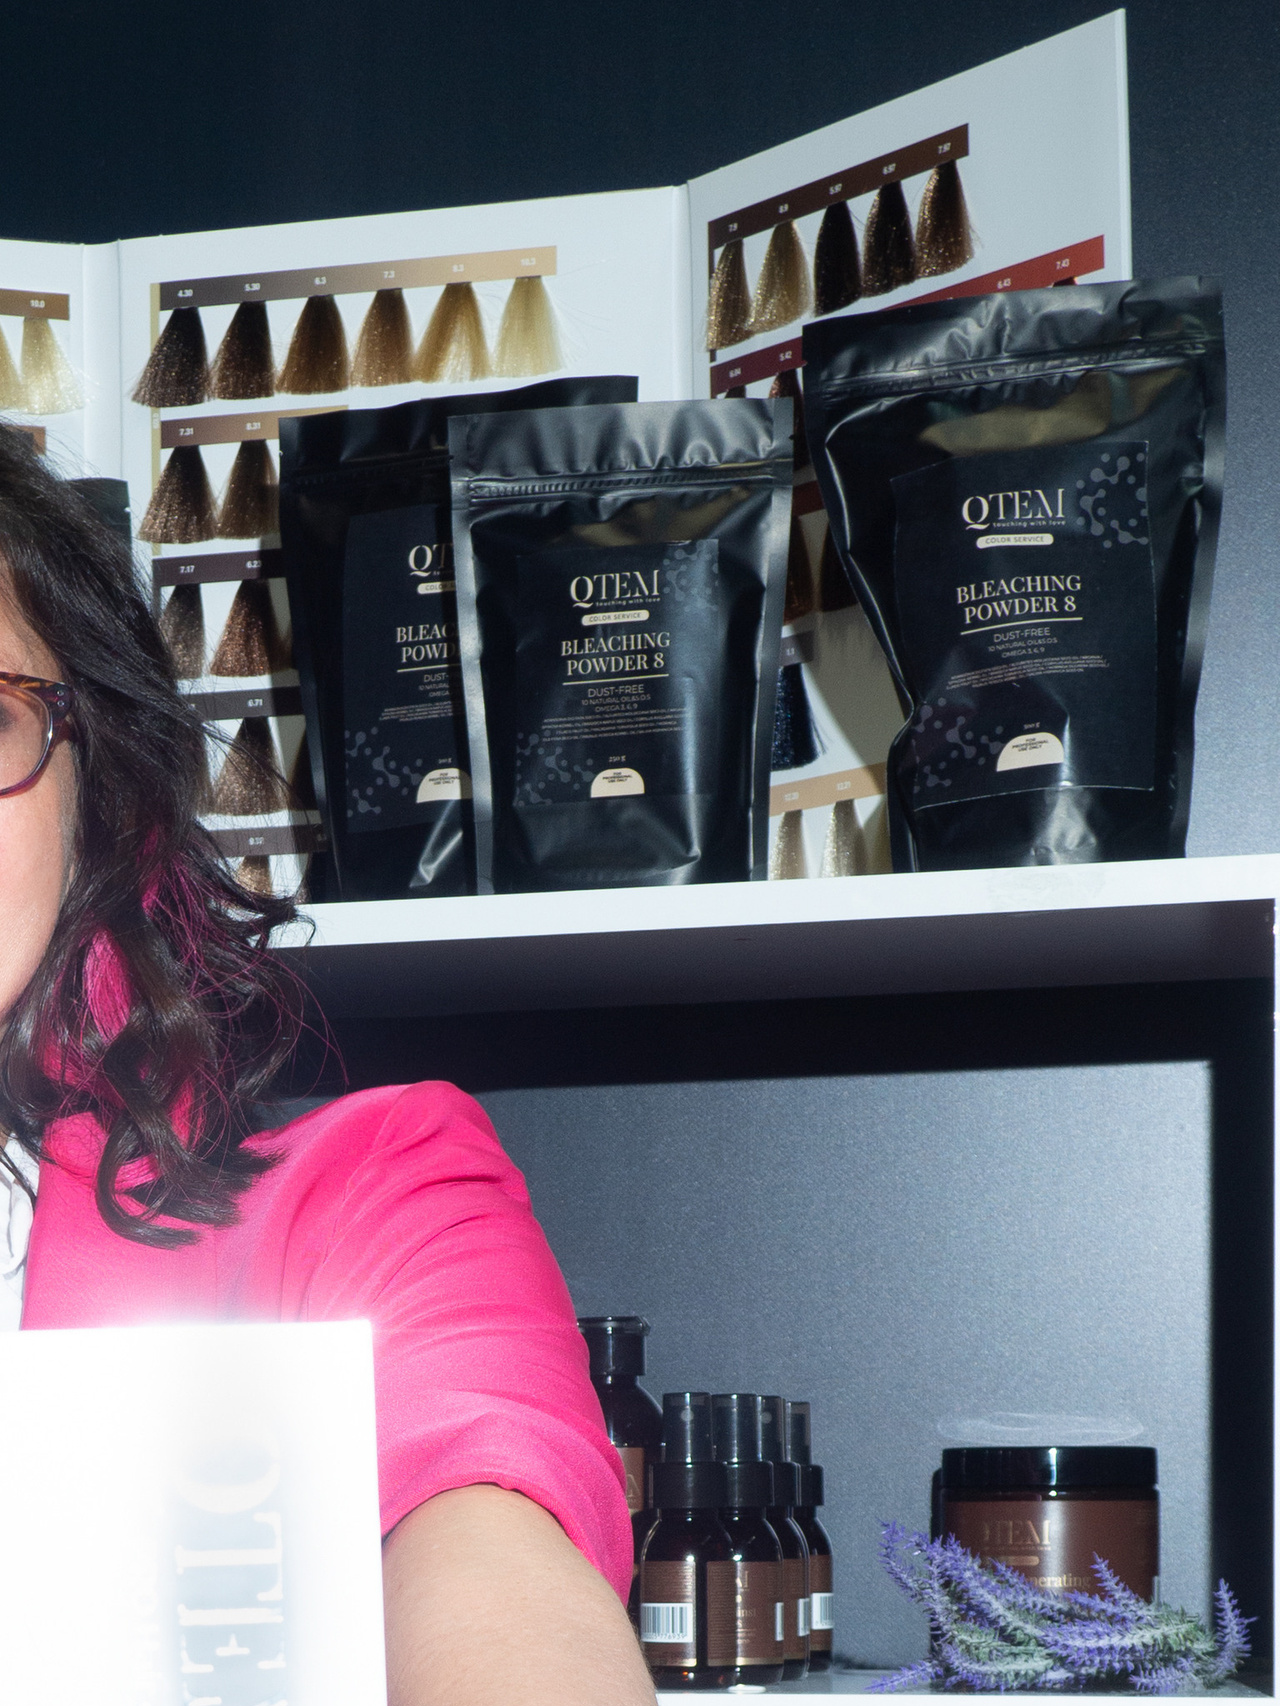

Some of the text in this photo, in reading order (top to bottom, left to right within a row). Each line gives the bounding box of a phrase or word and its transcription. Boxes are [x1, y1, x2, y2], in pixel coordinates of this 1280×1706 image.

[962, 488, 1065, 530] QTEM
[985, 535, 1045, 544] COLOR SERVICE
[570, 569, 660, 608] QTEM
[956, 575, 1082, 604] BLEACHING
[589, 612, 642, 622] COLOR SERVICE
[964, 595, 1077, 624] POWDER 8
[561, 631, 671, 657] BLEACHING
[993, 627, 1051, 643] DUST-FREE
[401, 642, 460, 663] POWD
[567, 652, 665, 676] POWDER 8
[587, 683, 645, 698] DUST-FREE
